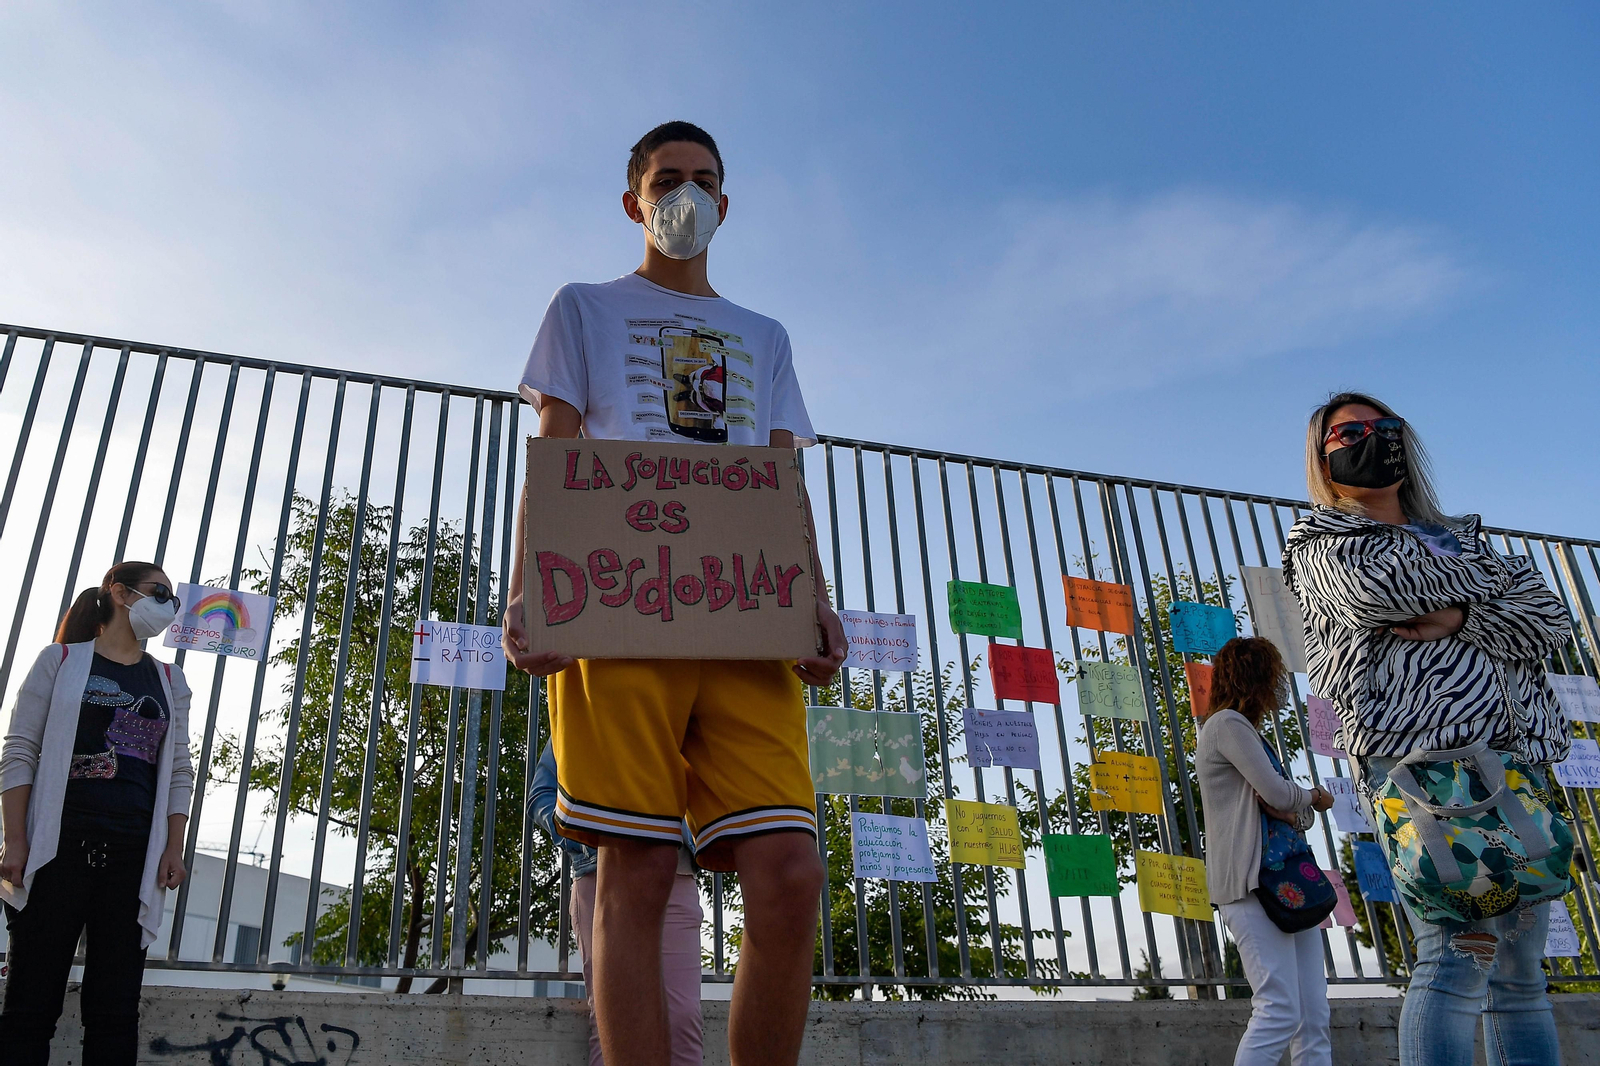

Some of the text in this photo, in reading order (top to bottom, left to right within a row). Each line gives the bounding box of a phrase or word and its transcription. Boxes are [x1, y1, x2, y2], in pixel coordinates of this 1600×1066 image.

[564, 450, 614, 490] LA
[1182, 606, 1216, 620] APOYO
[170, 624, 220, 639] QUEREMOS
[174, 636, 256, 658] COLE SEGURO
[441, 648, 494, 663] RATIO
[1098, 682, 1114, 692] EN
[955, 804, 1006, 826] No juguemos
[858, 817, 918, 839] Protejamos la
[990, 827, 1014, 837] SALUD
[951, 838, 959, 848] de
[859, 848, 901, 863] protejamos
[860, 862, 934, 877] niños y profesores
